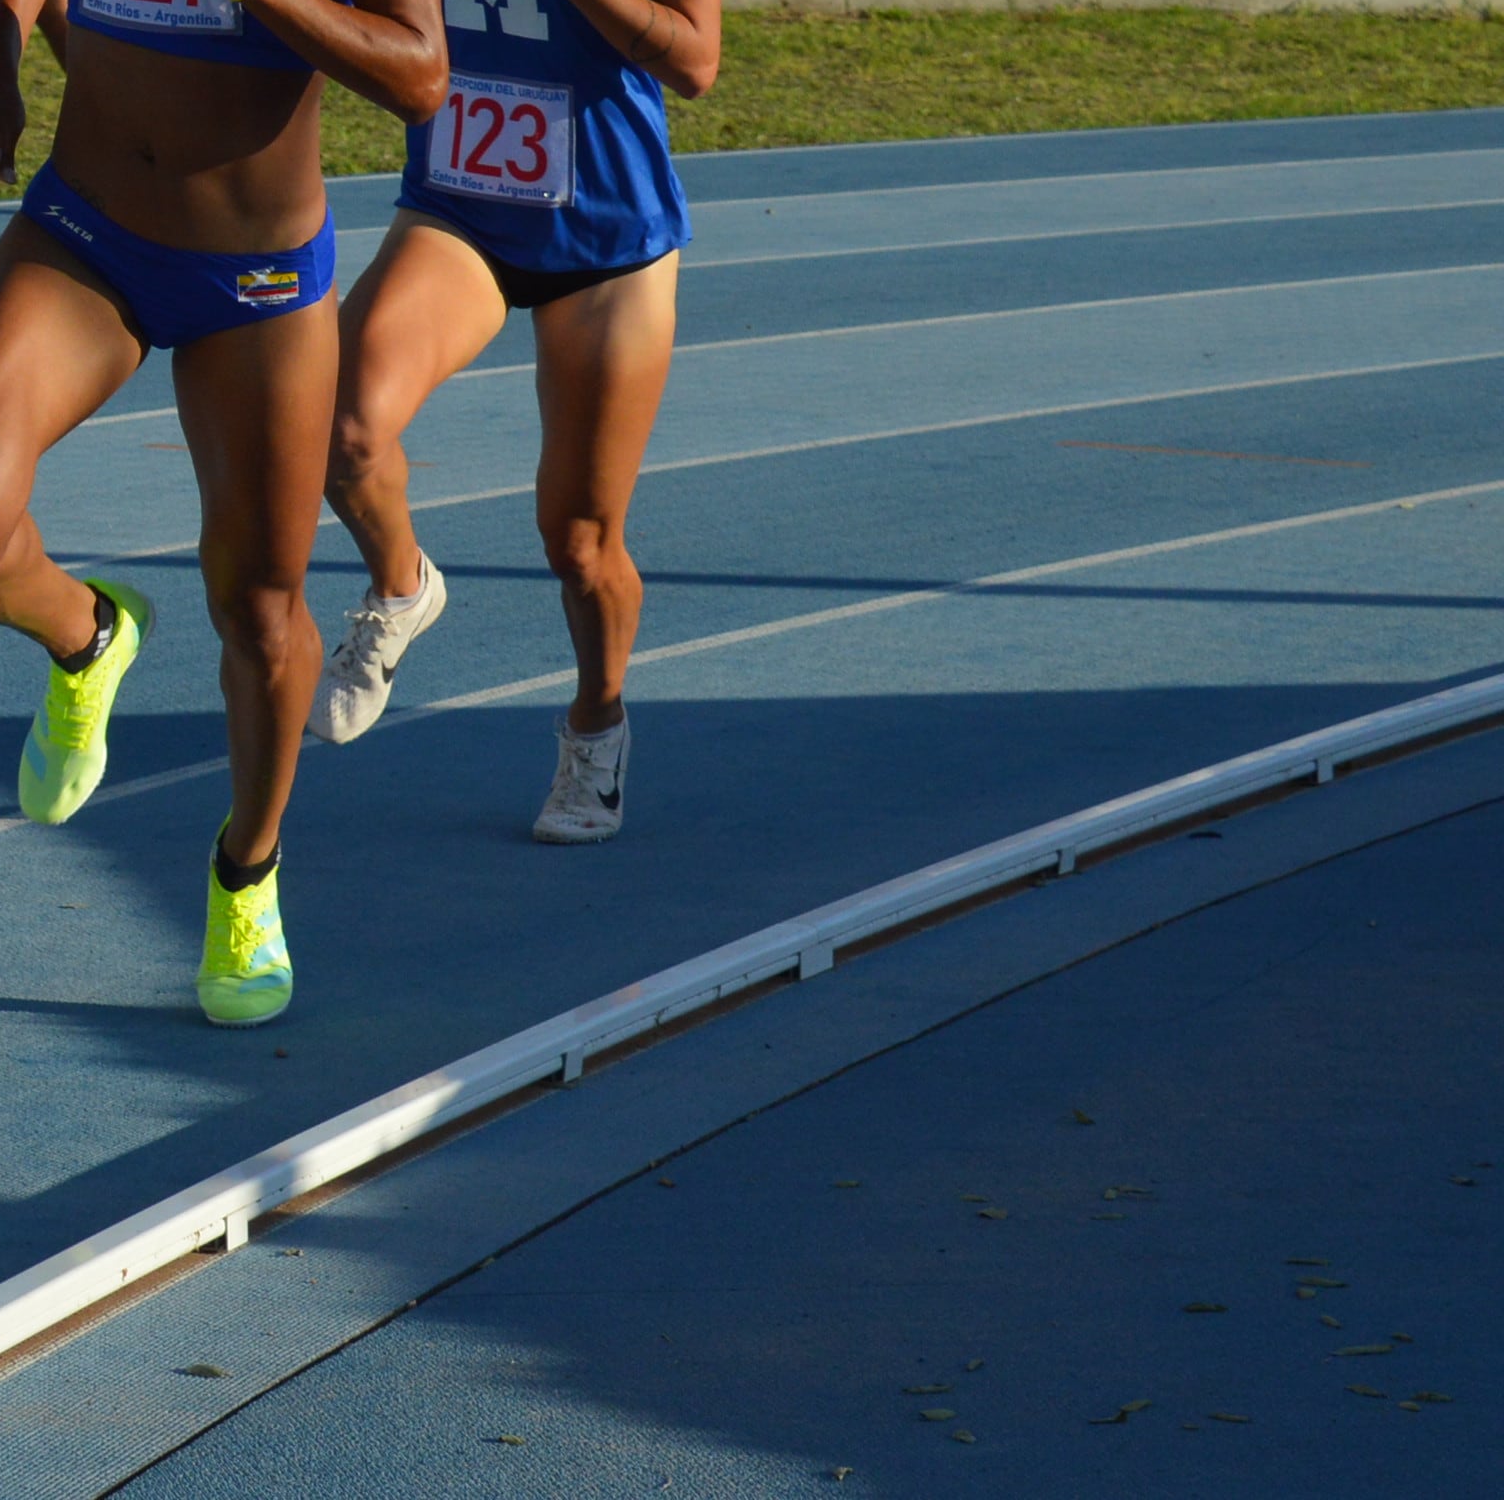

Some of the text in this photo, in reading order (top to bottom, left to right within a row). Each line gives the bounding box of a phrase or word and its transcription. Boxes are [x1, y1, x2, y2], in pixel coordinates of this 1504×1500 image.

[115, 2, 141, 19] Ríos
[154, 9, 222, 28] Argentina
[450, 75, 569, 102] CEPCION DEL URUGUAY
[448, 92, 548, 183] 123
[432, 169, 458, 186] Entre
[460, 175, 485, 191] Ríos
